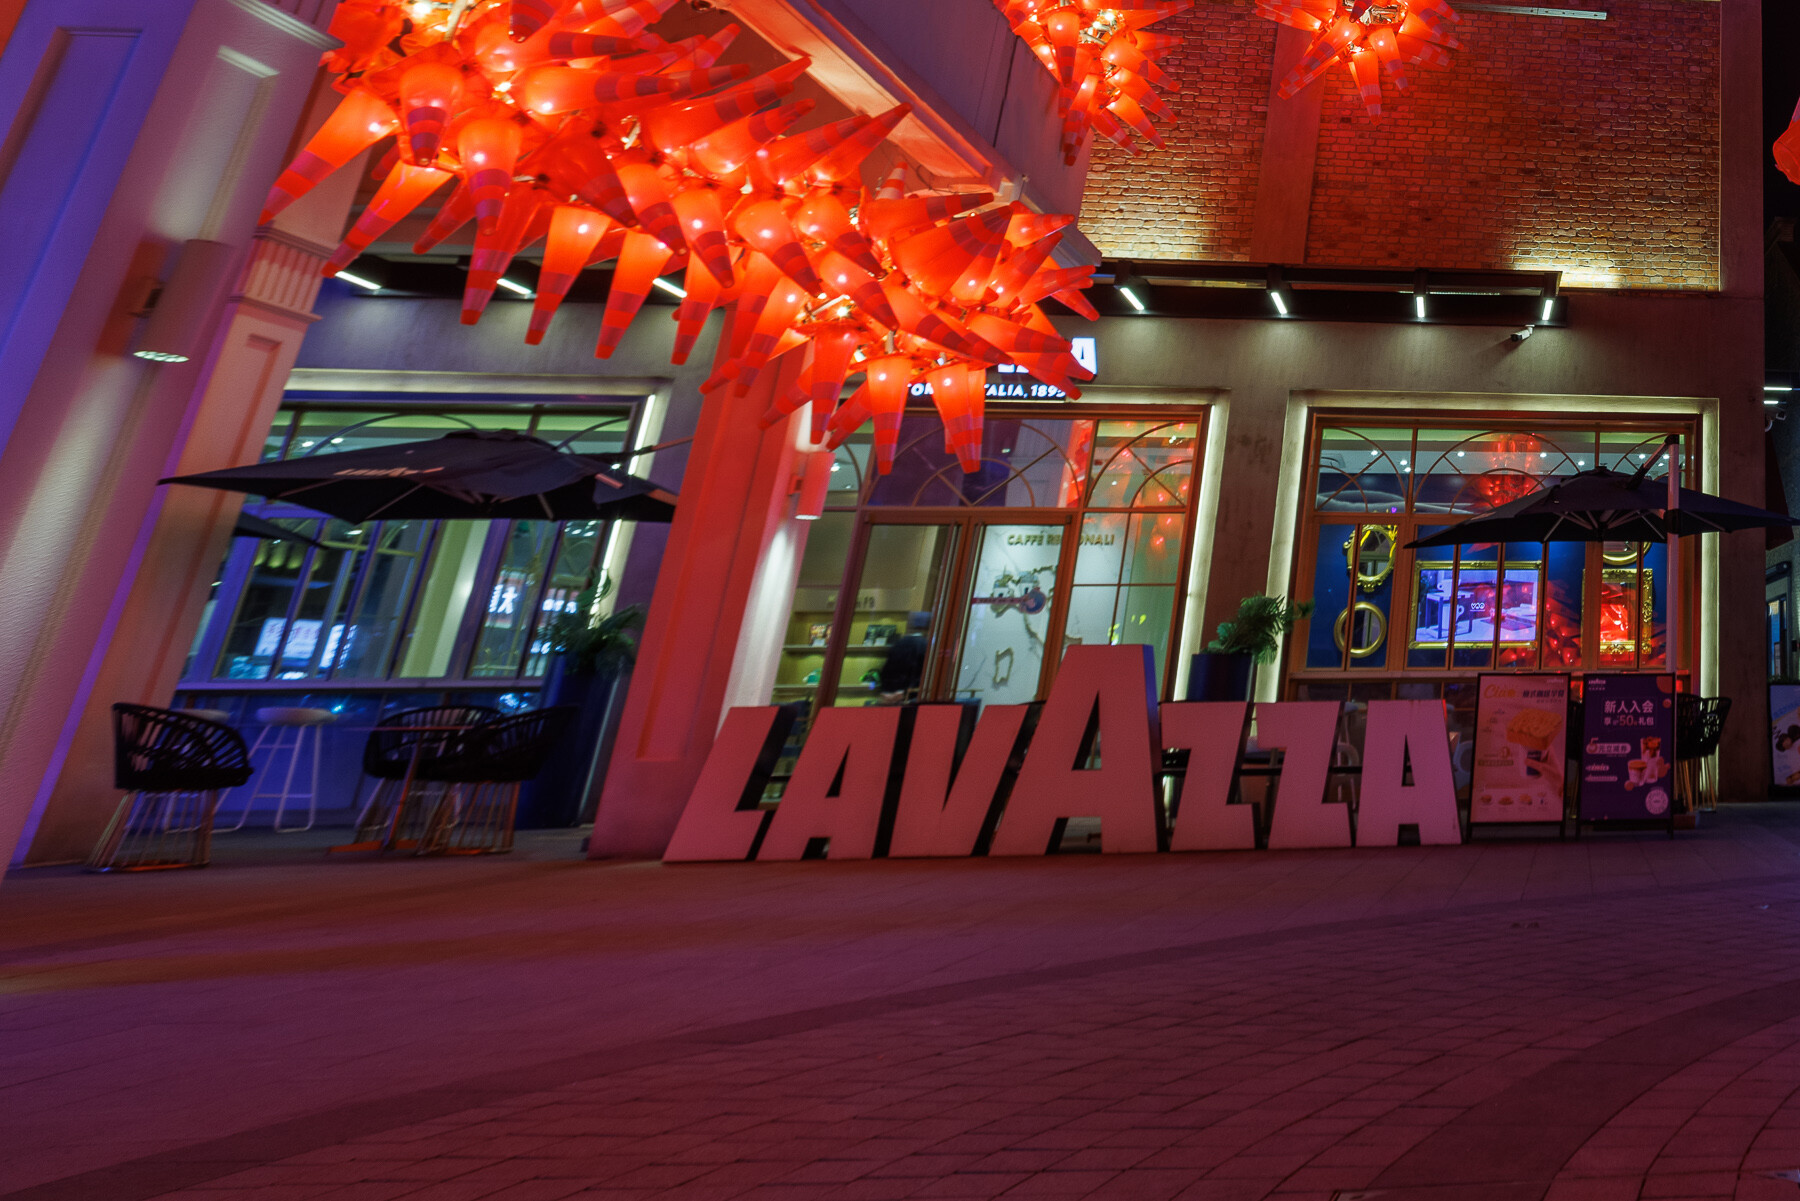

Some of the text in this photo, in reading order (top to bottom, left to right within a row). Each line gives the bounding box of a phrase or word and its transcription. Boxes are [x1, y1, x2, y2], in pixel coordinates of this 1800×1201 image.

[663, 644, 1462, 863] LAVAZZA
[1604, 700, 1654, 714] 新人入会
